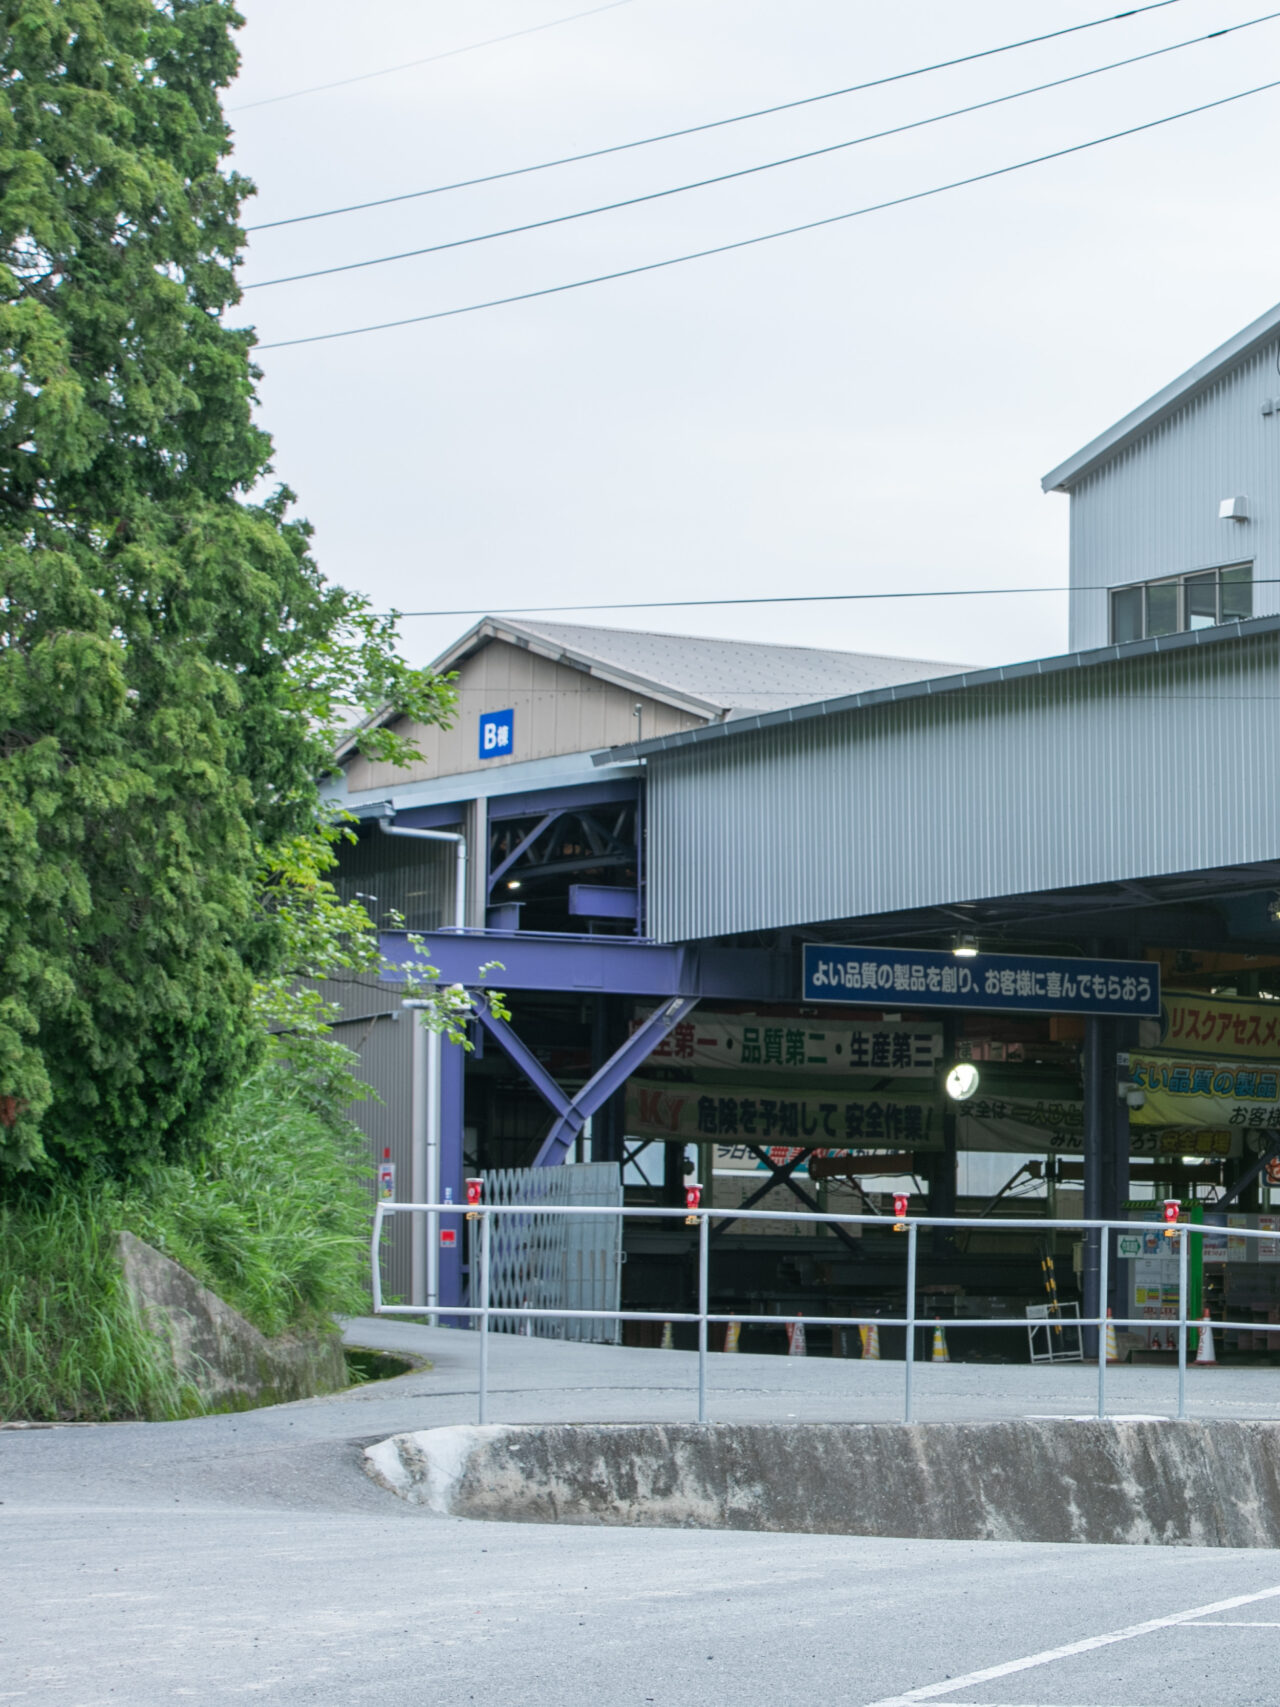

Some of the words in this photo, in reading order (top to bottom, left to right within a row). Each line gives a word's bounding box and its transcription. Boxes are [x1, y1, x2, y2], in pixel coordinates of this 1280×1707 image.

[484, 723, 509, 750] B棟
[813, 961, 1151, 1002] よい品質の製品を創り、お客様に喜んでもらおう
[638, 1089, 684, 1131] KY
